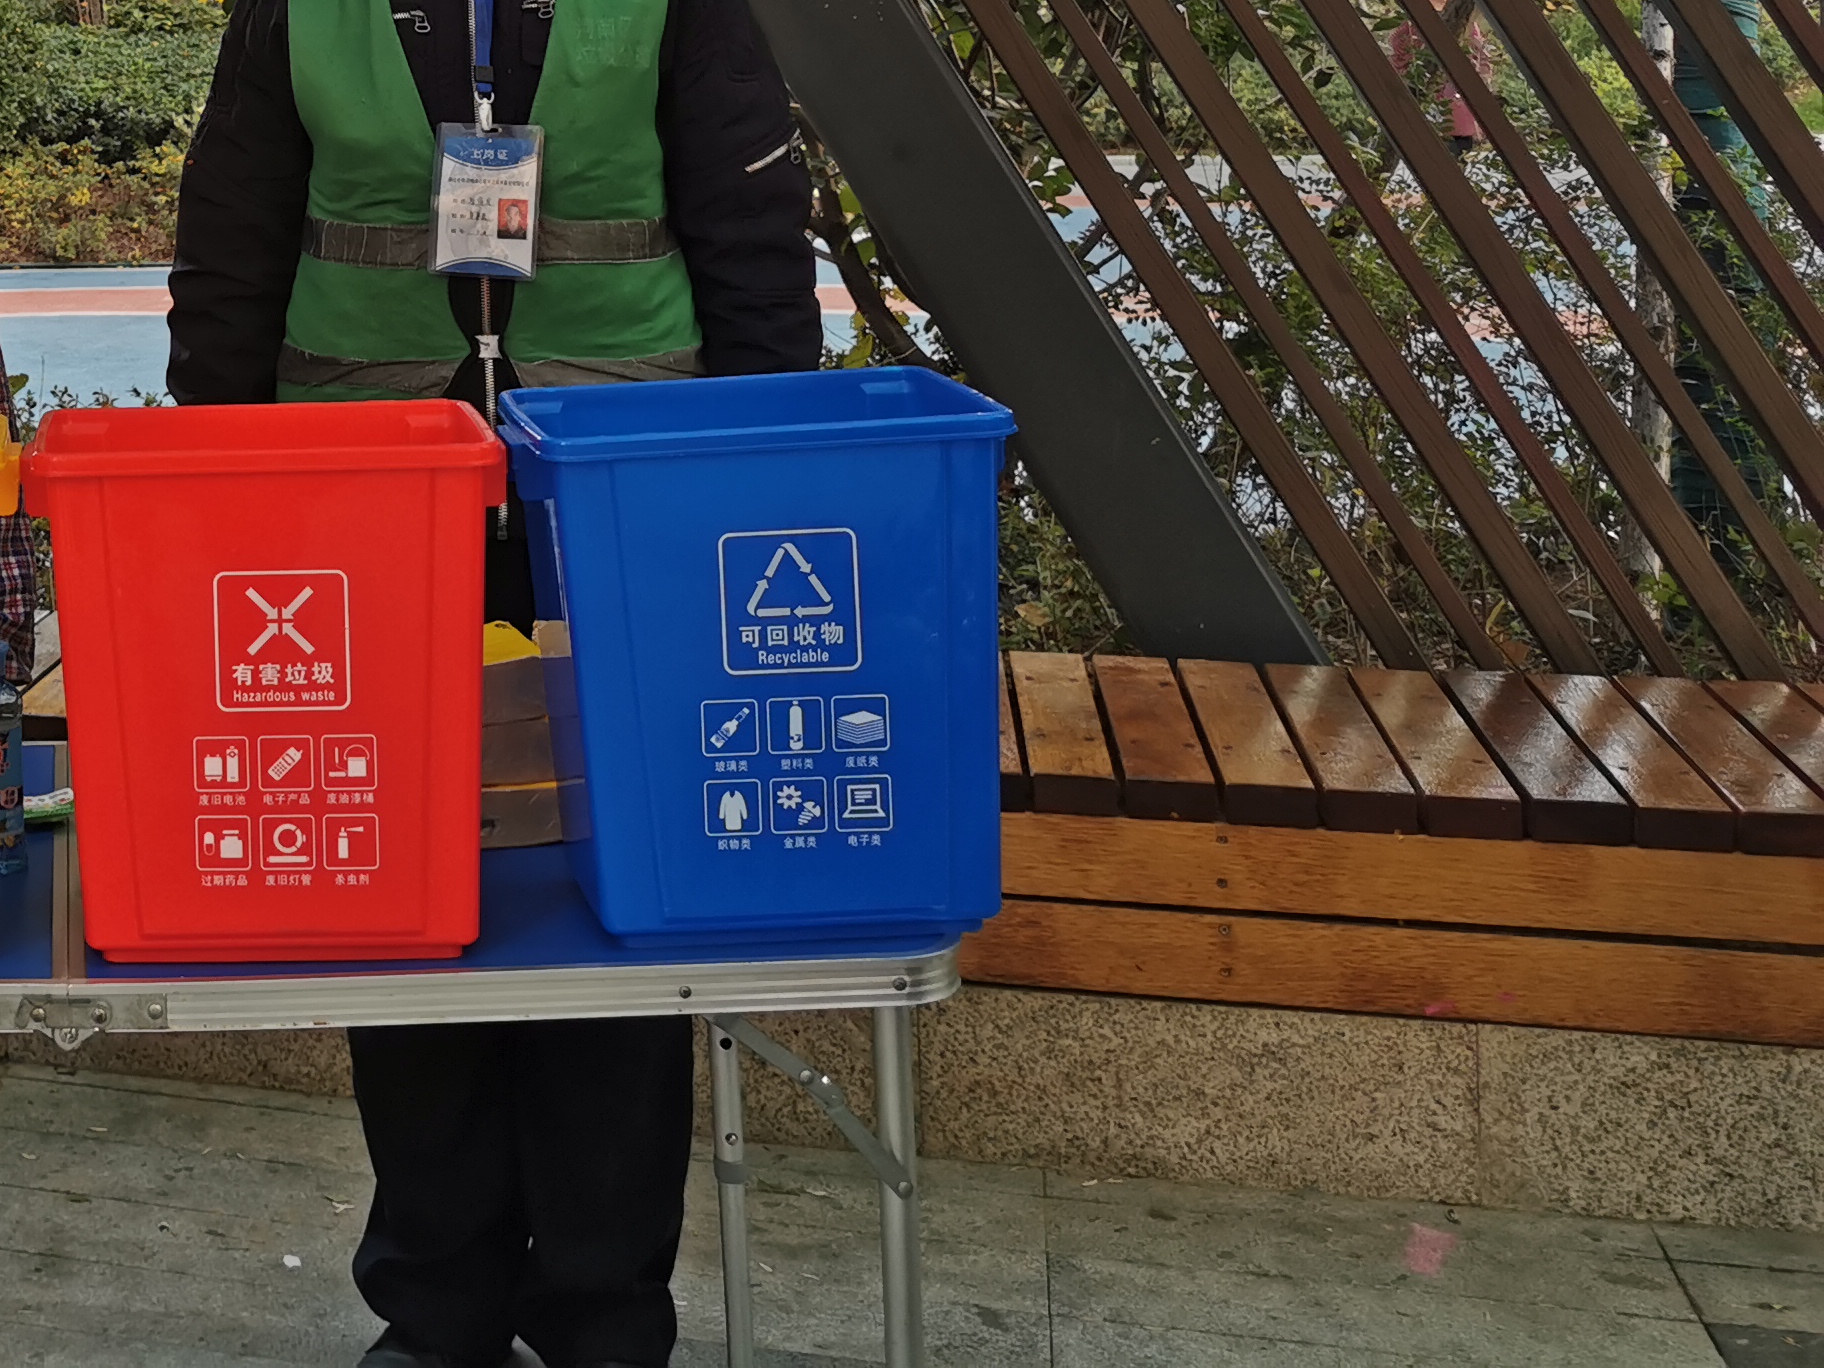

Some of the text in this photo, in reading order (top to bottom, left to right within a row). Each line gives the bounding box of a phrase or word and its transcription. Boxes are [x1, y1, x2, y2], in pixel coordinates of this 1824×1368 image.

[738, 622, 844, 648] 可回收物
[758, 648, 830, 666] Recyclable
[232, 662, 335, 685] 有害垃圾
[233, 689, 335, 702] Hazardous waste
[714, 760, 748, 772] 玻璃类
[780, 758, 814, 770] 塑料类
[845, 756, 879, 768] 废纸类
[198, 794, 247, 806] 废旧电池
[263, 793, 311, 805] 电子产品
[326, 792, 375, 804] 废油漆桶
[717, 838, 752, 851] 织物类
[783, 836, 817, 849] 金属类
[847, 834, 882, 847] 电子类
[201, 874, 248, 887] 过期药品
[265, 873, 312, 886] 废旧灯管
[334, 873, 370, 885] 杀虫剂
